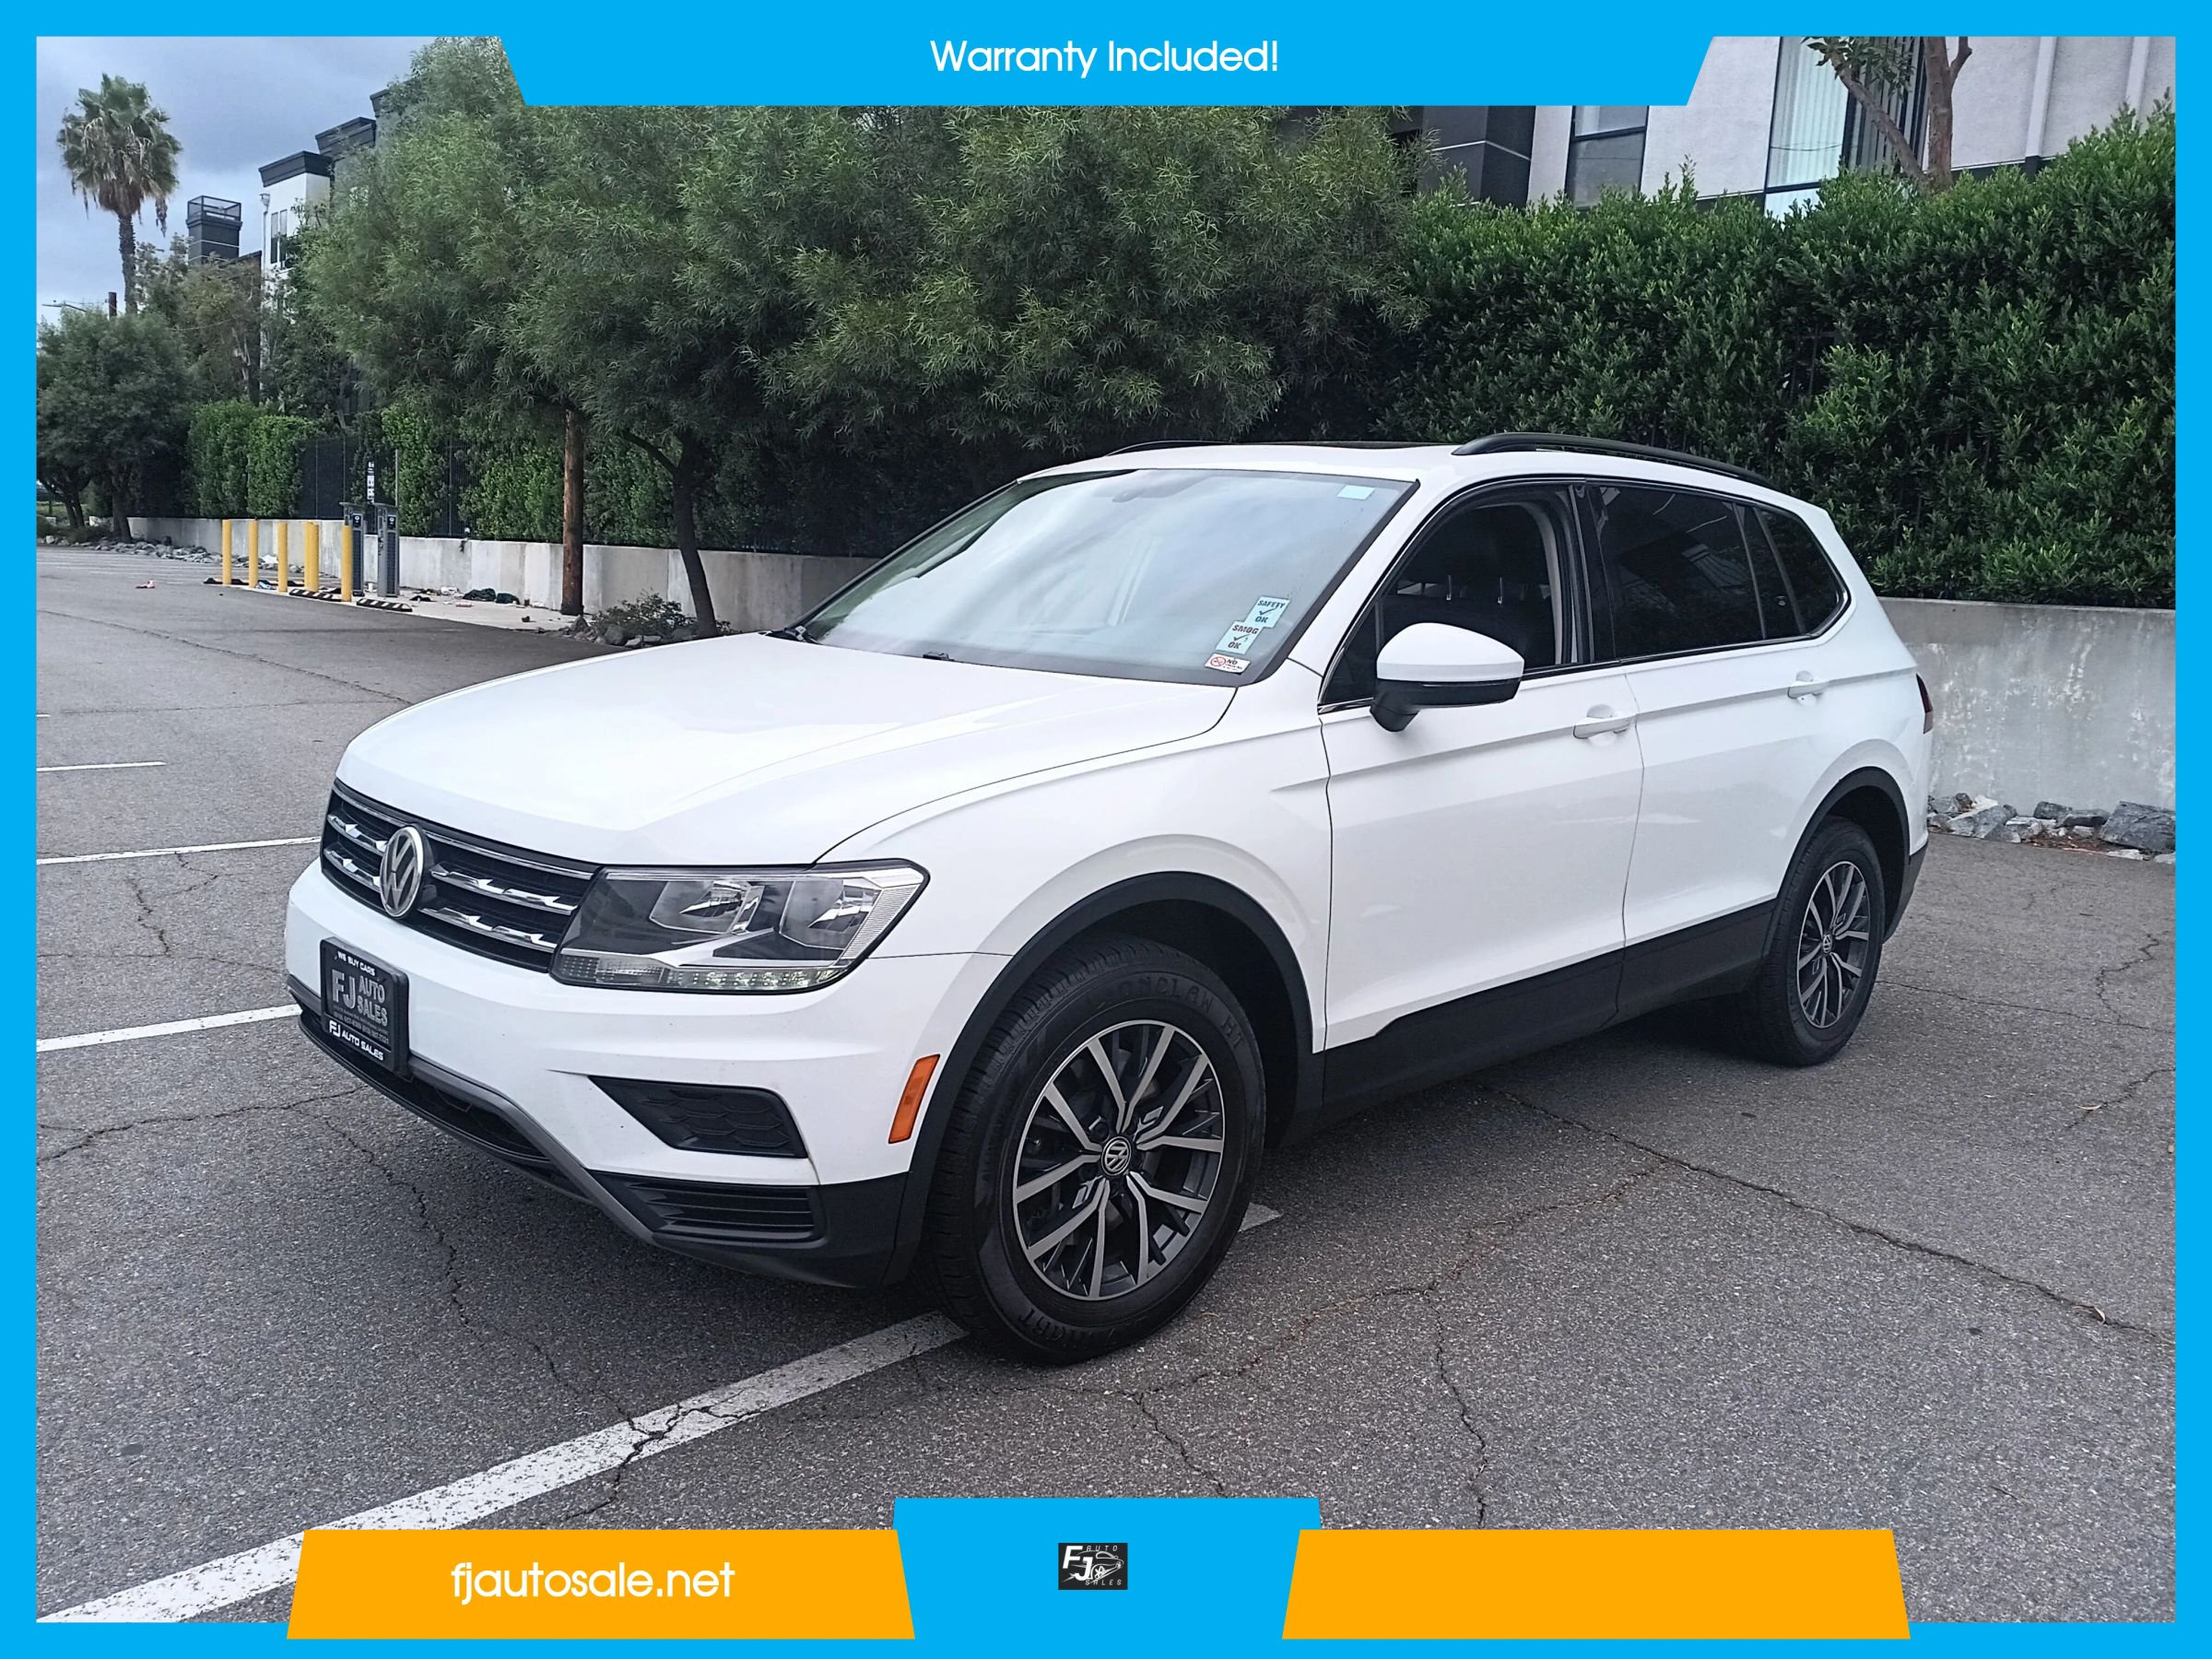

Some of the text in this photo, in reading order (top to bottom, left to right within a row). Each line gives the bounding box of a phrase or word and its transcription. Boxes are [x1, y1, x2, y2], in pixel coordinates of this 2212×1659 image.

[1257, 599, 1286, 609] SAFETY
[1231, 625, 1260, 635] SMOG
[1227, 641, 1241, 650] OK
[337, 950, 376, 976] WE BUY CARS
[332, 969, 356, 1009] FJ
[359, 975, 385, 1004] AUTO
[357, 994, 388, 1027] SALES
[329, 1019, 341, 1038] FJ
[341, 1030, 360, 1047] AUTO
[360, 1041, 384, 1061] SALES
